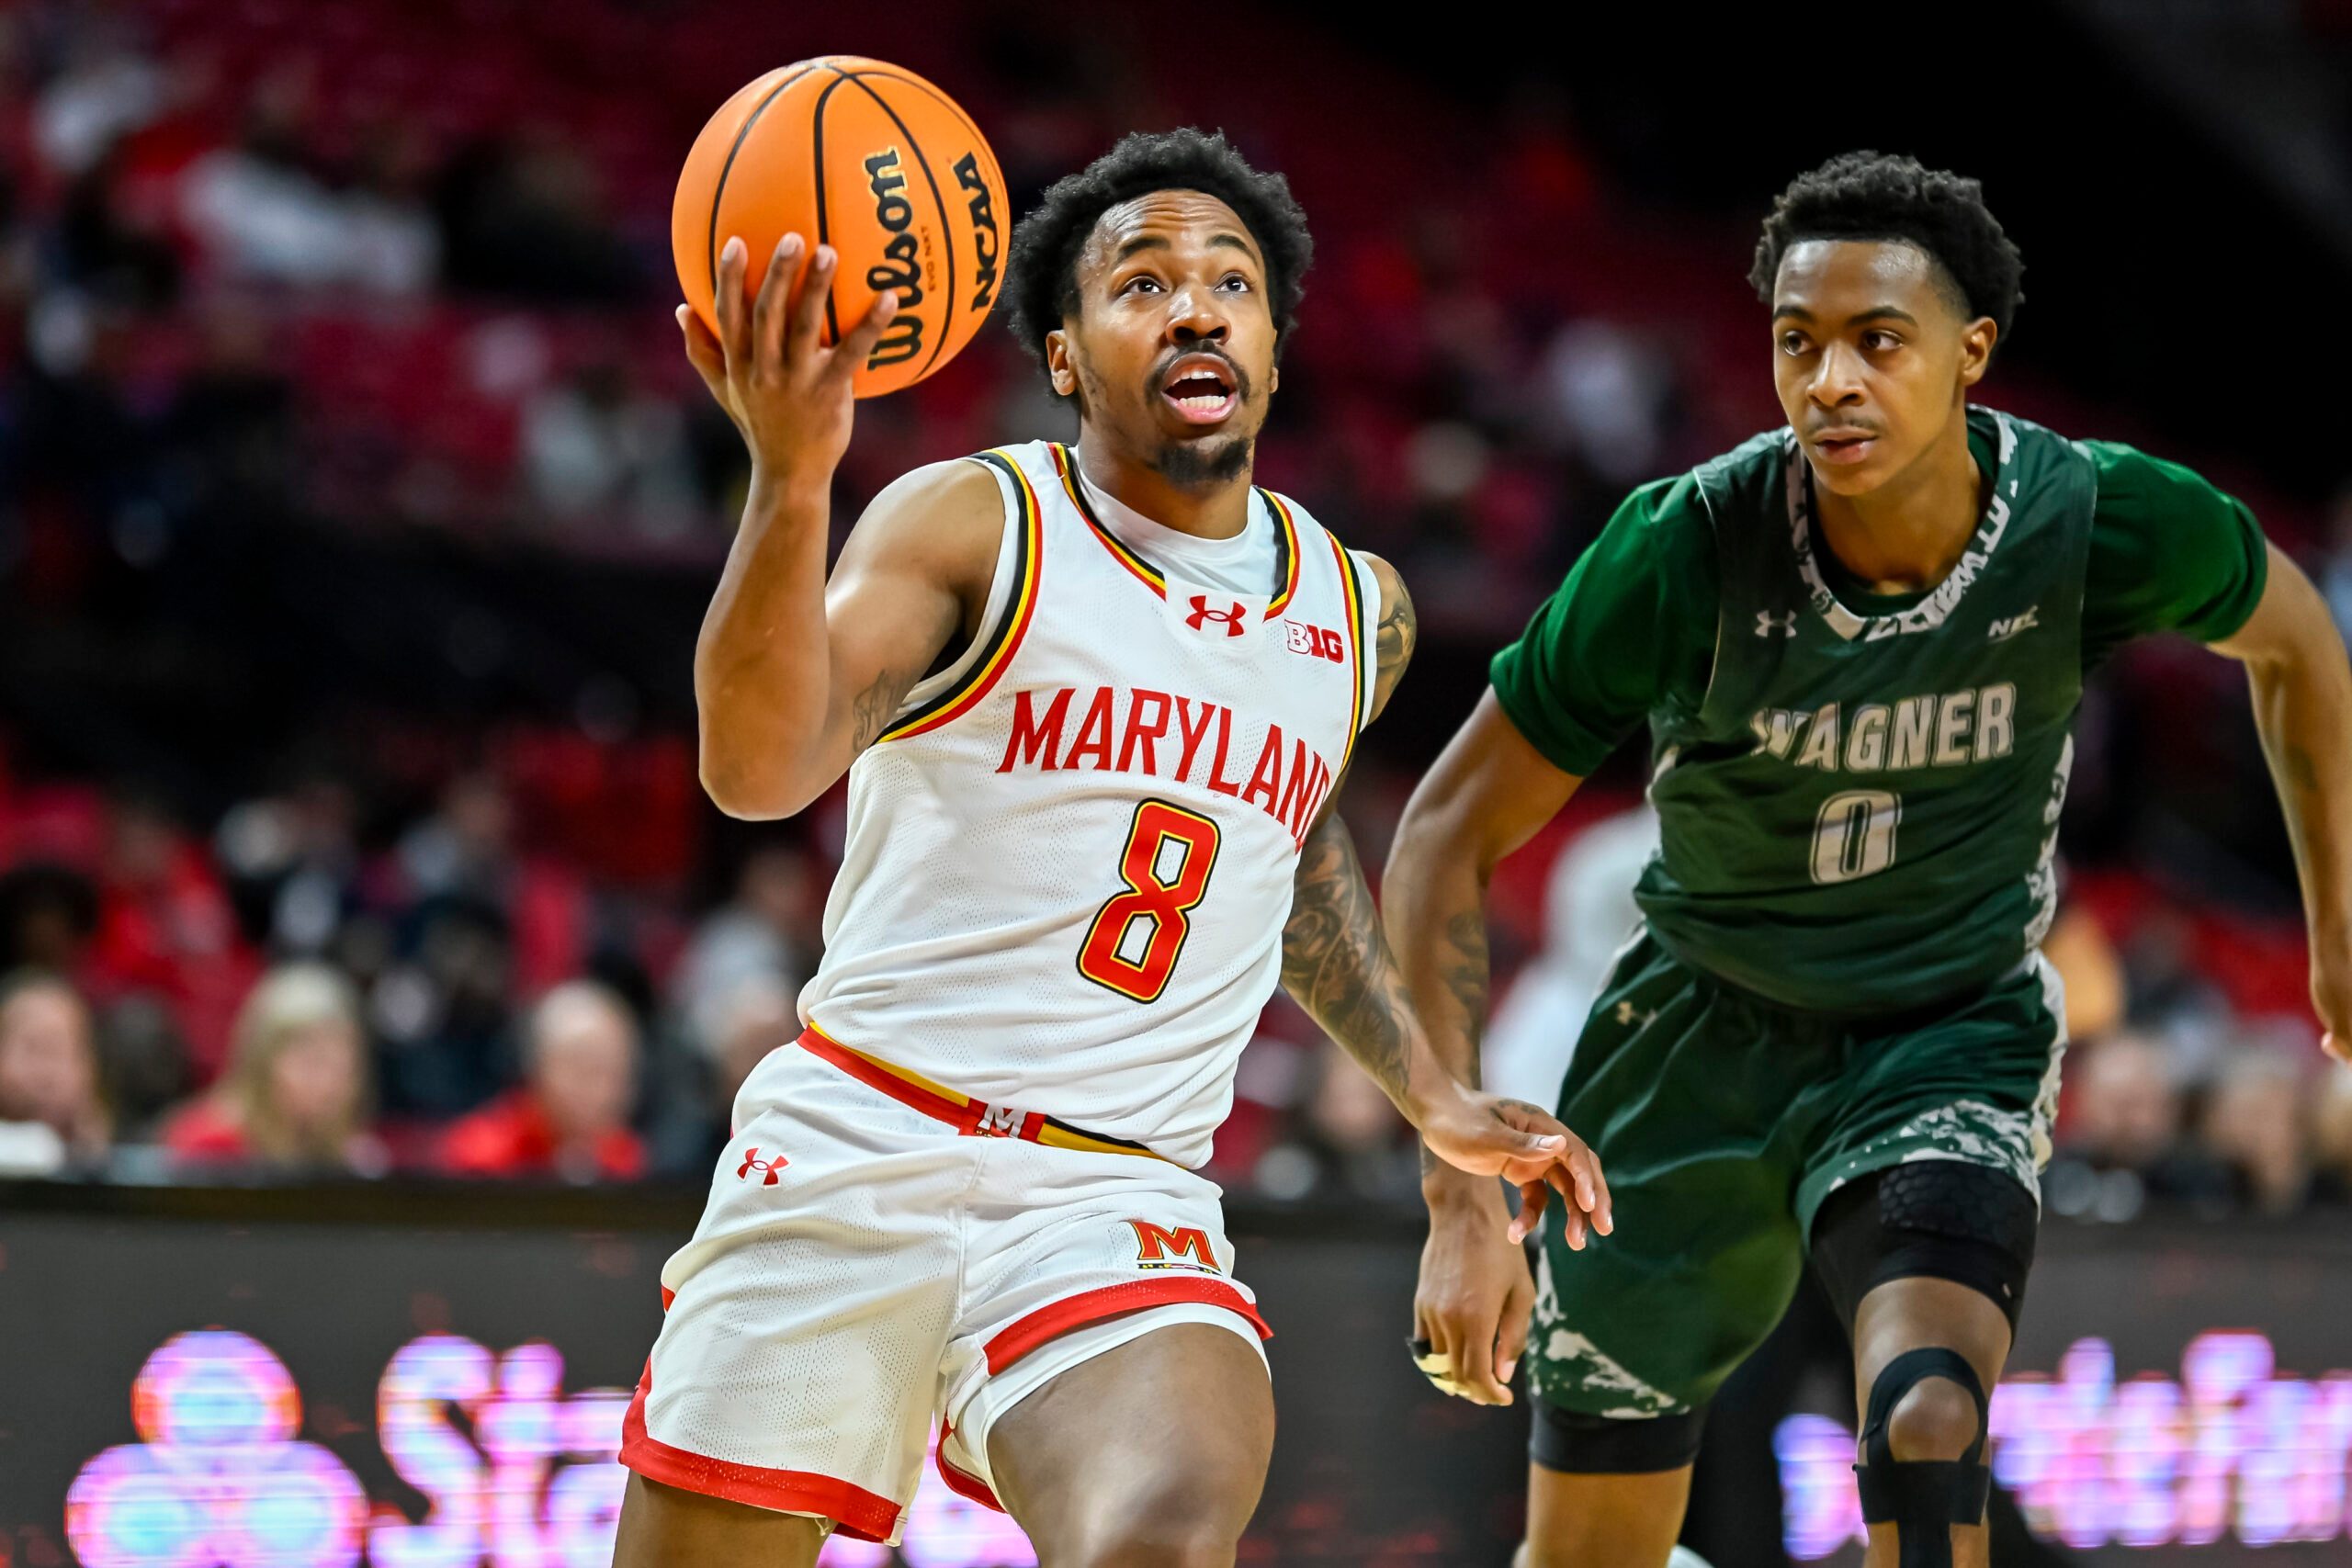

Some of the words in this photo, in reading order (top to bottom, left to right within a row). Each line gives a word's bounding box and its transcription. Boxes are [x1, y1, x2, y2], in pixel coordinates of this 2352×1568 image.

[863, 146, 923, 370] Wilson
[952, 151, 999, 312] NCAA
[995, 686, 1329, 854] MARYLAND
[1750, 682, 2017, 773] WAGNER
[1076, 796, 1222, 1005] 8
[1808, 789, 1903, 886] 0
[1131, 1221, 1222, 1273] M
